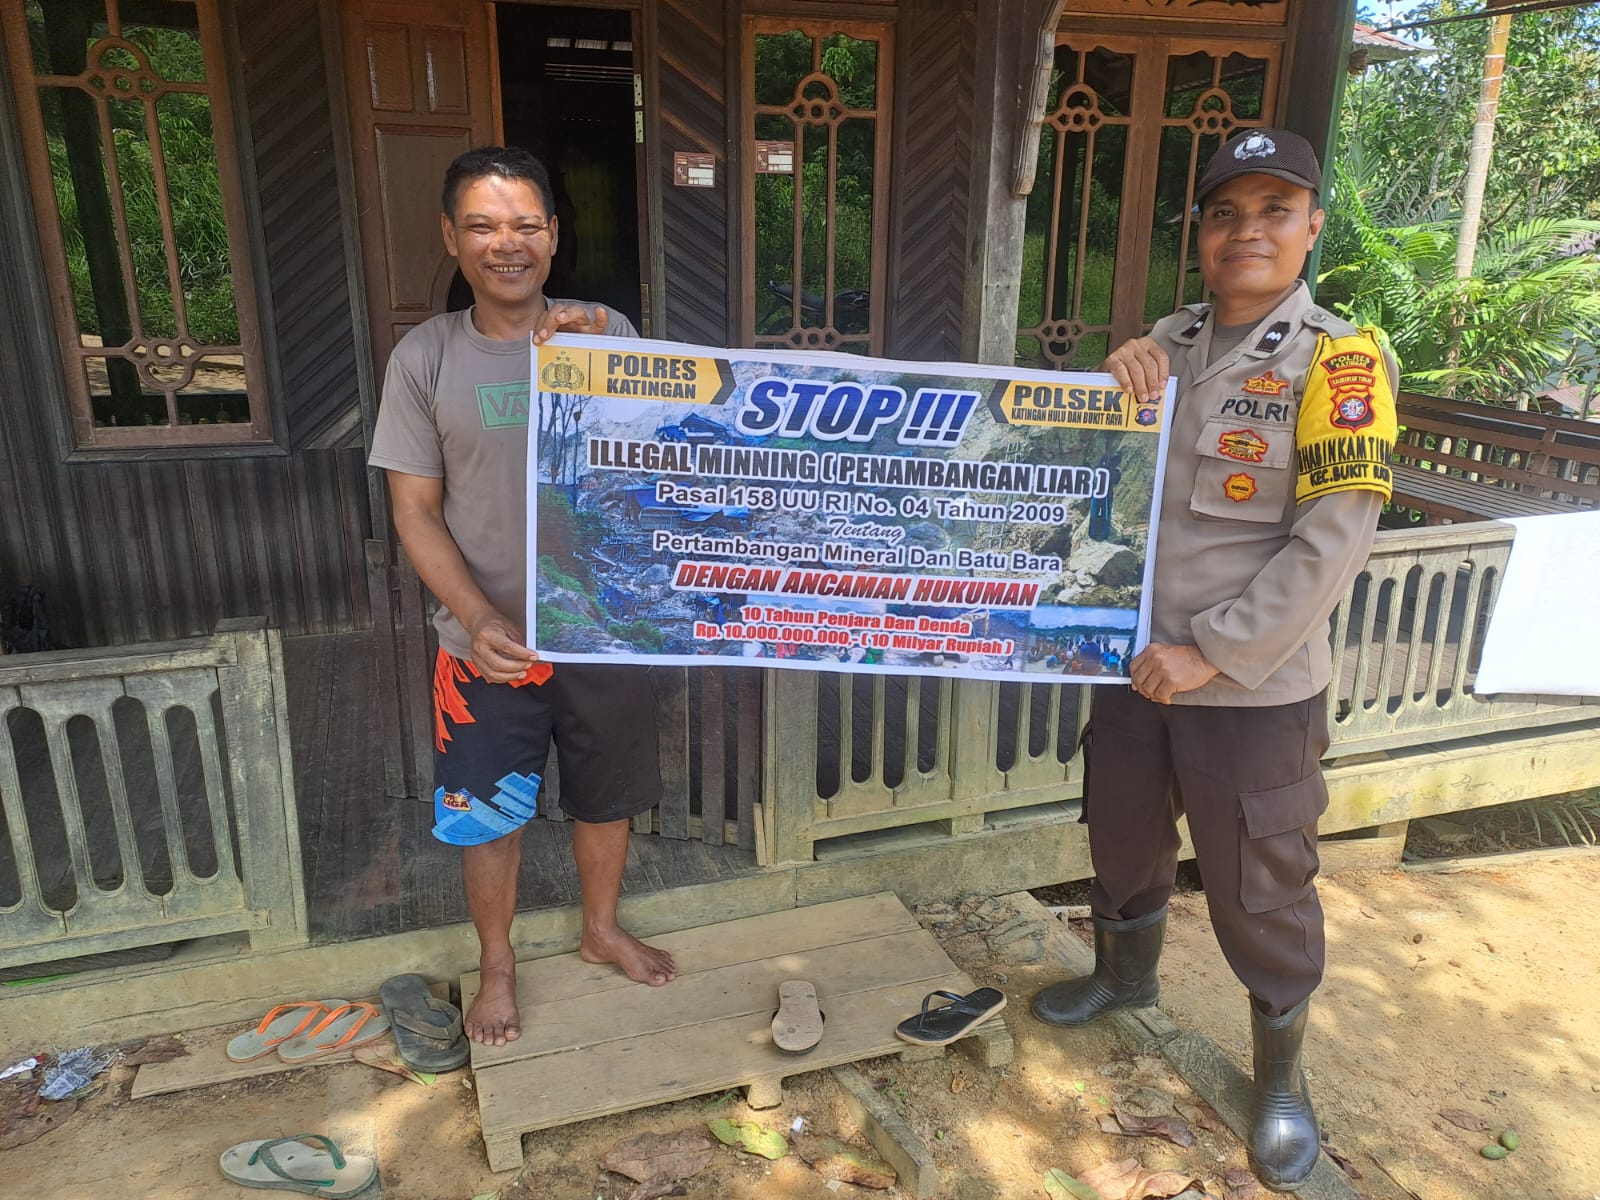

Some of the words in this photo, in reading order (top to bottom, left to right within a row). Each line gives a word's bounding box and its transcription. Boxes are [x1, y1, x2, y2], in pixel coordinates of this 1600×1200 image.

[607, 353, 697, 381] POLRES
[1330, 354, 1371, 366] POLRES
[607, 377, 697, 399] KATINGAN
[1014, 385, 1124, 412] POLSEK
[486, 391, 530, 417] VA
[740, 379, 901, 438] STOP
[903, 392, 977, 442] !!!
[1011, 407, 1046, 421] KATINGAN
[1047, 409, 1066, 422] HULU
[1067, 410, 1081, 423] DAN
[1083, 411, 1104, 425] BUKIT
[1105, 413, 1123, 426] RAYA
[1220, 398, 1289, 422] POLRI
[589, 439, 692, 473] ILLEGAL
[699, 447, 816, 480] MINNING
[658, 483, 726, 504] Pasal
[734, 488, 774, 507] 158
[782, 491, 817, 510] UU
[825, 494, 849, 512] RI
[856, 495, 895, 515] No.
[902, 498, 929, 516] 04
[937, 500, 1005, 520] Tahun
[1012, 504, 1065, 522] 2009
[828, 518, 904, 543] Tentang
[655, 533, 816, 561] Pertambangan
[824, 544, 903, 565] Mineral
[911, 548, 951, 567] Dan
[958, 551, 1006, 569] Batu
[1013, 553, 1060, 572] Bara
[676, 564, 781, 592] DENGAN
[781, 571, 912, 600] ANCAMAN
[912, 579, 1039, 607] HUKUMAN
[743, 606, 761, 621] 10
[765, 608, 815, 625] Tahun
[817, 611, 881, 628] Penjara
[884, 614, 915, 631] Dan
[919, 616, 970, 634] Denda
[695, 623, 720, 639] Rp.
[724, 625, 858, 647] 10.000.000.000,-
[892, 635, 943, 651] Milyar
